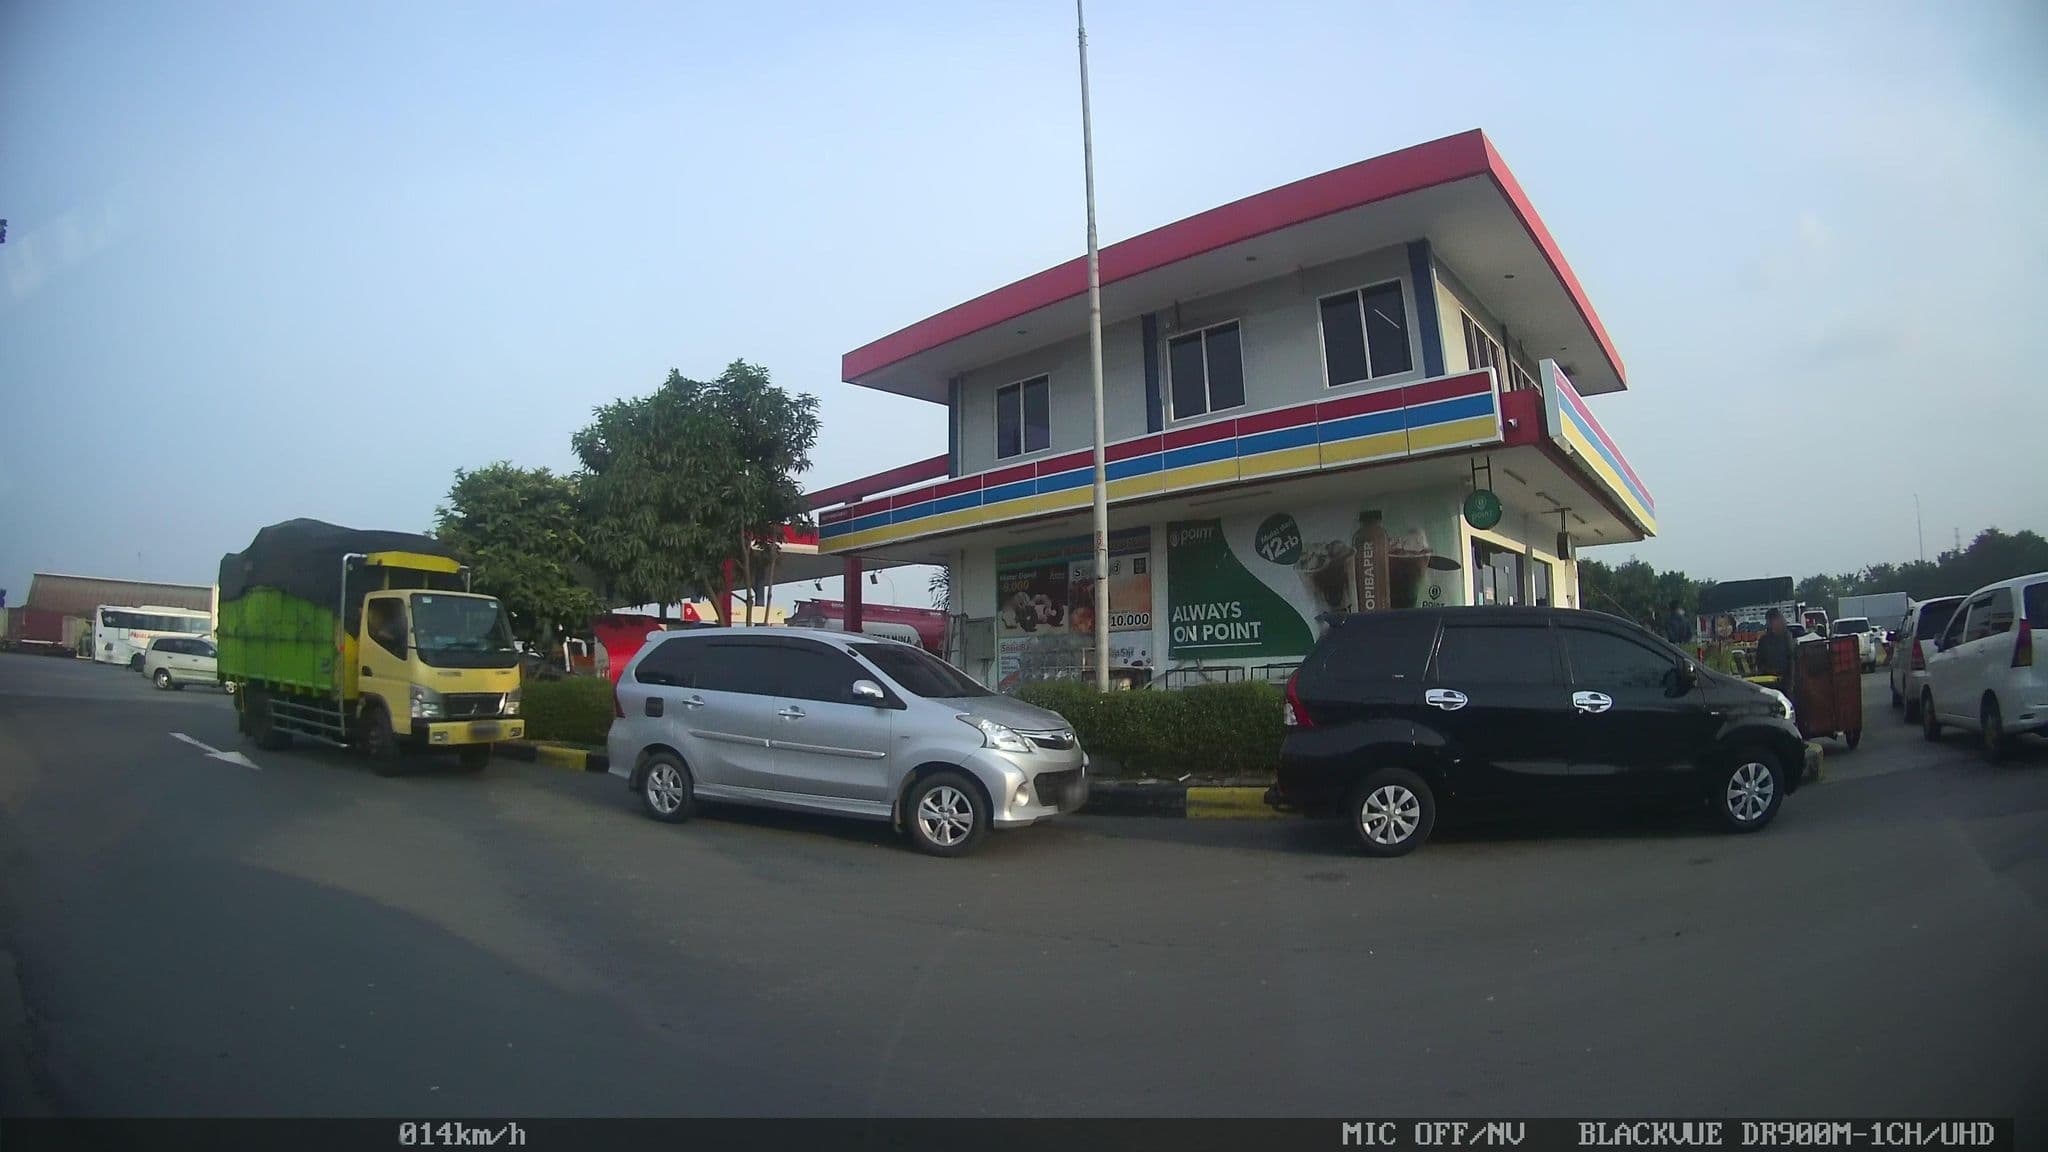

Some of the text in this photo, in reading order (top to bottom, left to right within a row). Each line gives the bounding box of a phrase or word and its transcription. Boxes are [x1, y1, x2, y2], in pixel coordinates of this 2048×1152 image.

[1261, 535, 1299, 561] 12rb
[1363, 541, 1376, 611] OPIBAPER
[1111, 613, 1149, 627] 10.000
[1172, 601, 1242, 622] ALWAYS
[1173, 621, 1261, 643] ON POINT
